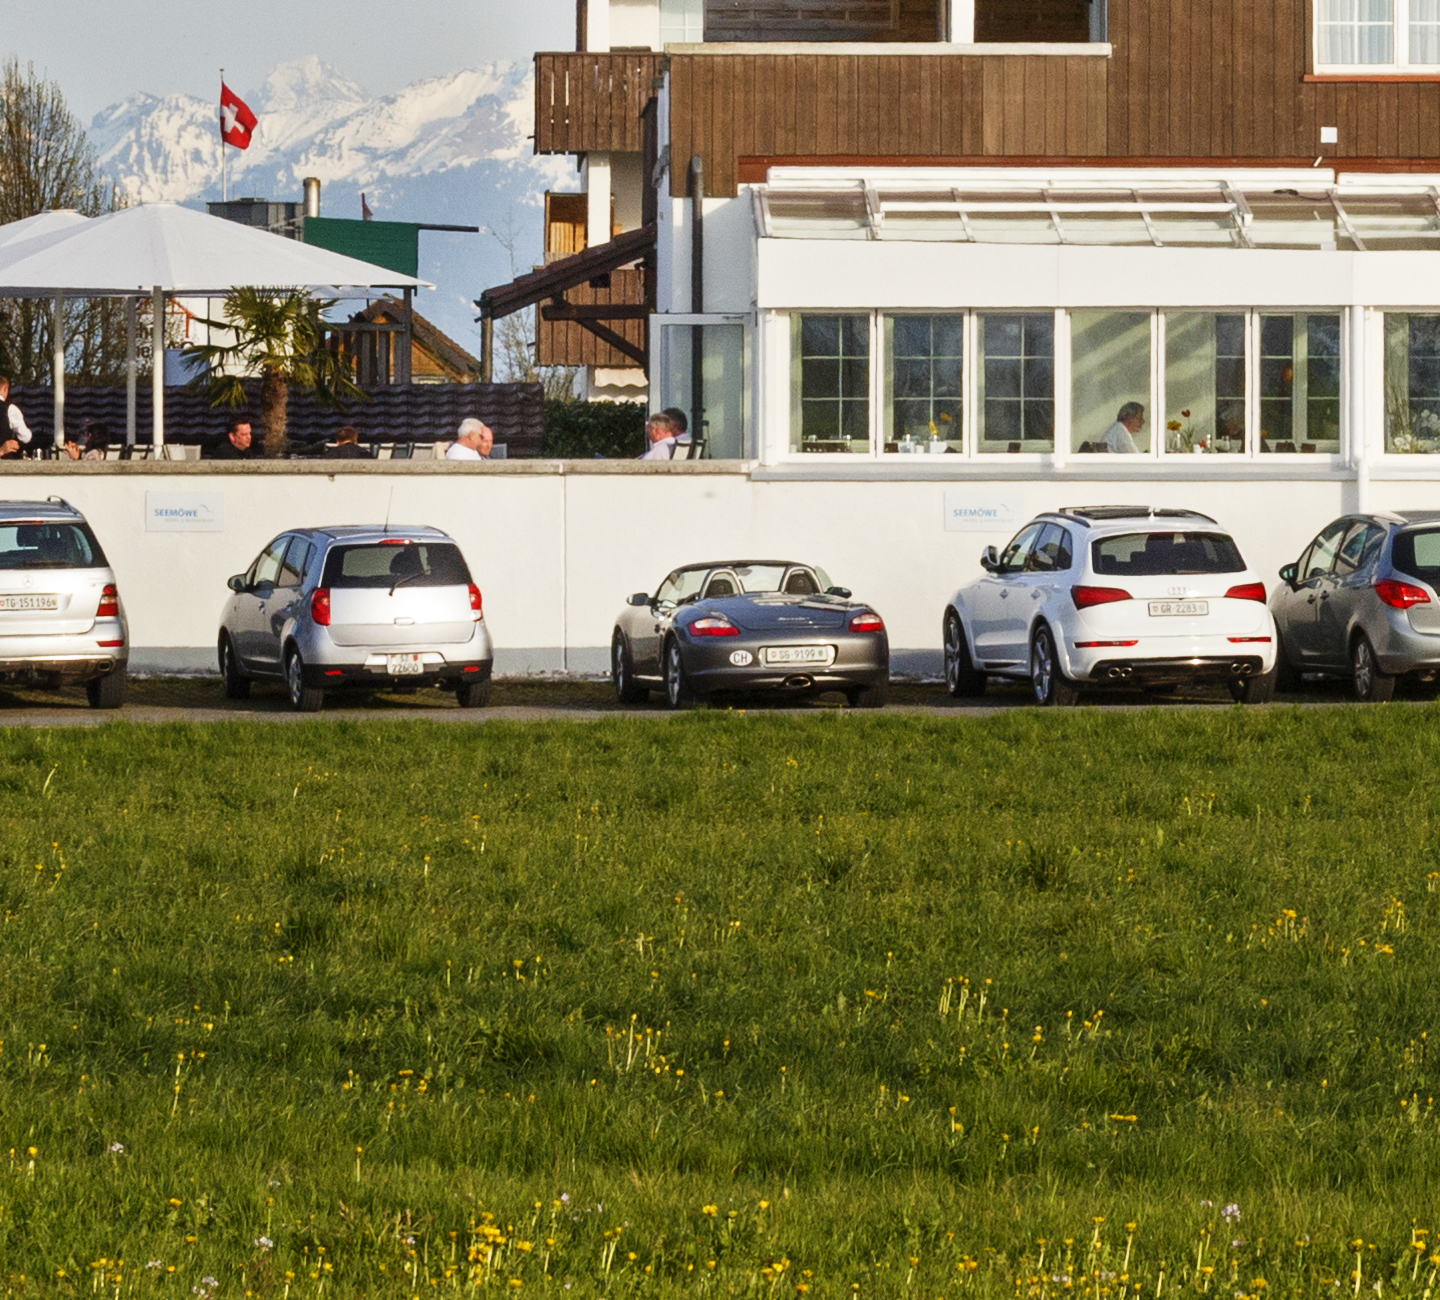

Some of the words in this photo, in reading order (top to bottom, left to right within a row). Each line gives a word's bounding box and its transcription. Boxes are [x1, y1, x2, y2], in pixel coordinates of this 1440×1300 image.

[154, 507, 198, 517] SEEMÖWE
[953, 507, 998, 517] SEEMÖWE
[733, 653, 748, 663] CH
